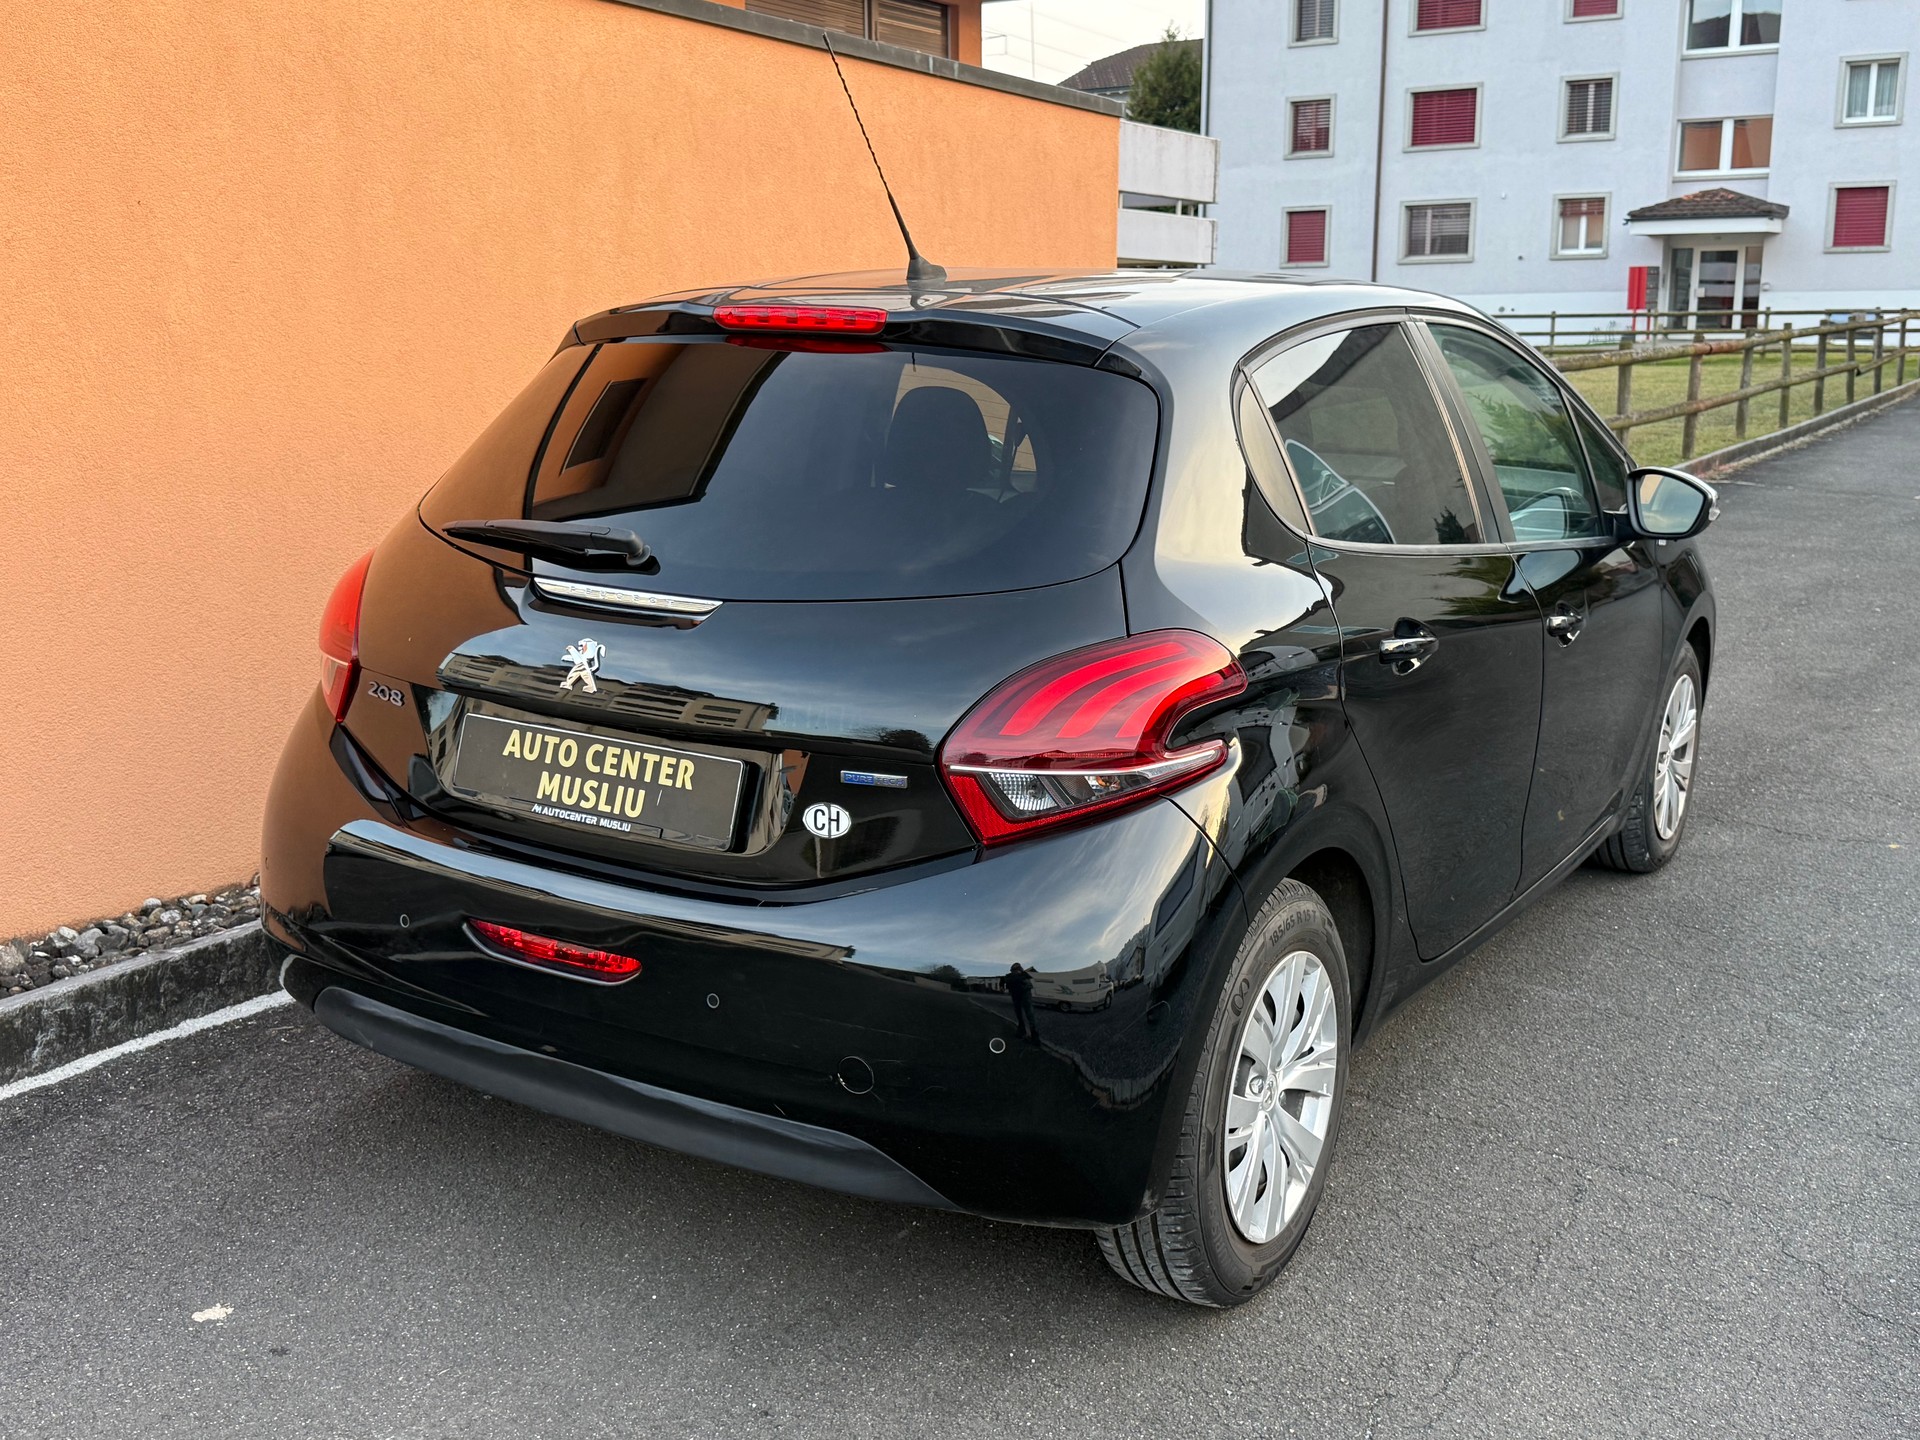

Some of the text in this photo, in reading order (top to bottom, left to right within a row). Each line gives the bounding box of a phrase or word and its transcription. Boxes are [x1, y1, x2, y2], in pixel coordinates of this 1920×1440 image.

[367, 681, 404, 707] 208
[502, 729, 695, 790] AUTO CENTER
[536, 771, 646, 818] MUSLIU
[542, 807, 597, 825] AUTOCENTER
[599, 818, 631, 832] MUSLIU
[814, 809, 840, 832] CH
[1269, 914, 1295, 947] 185/65
